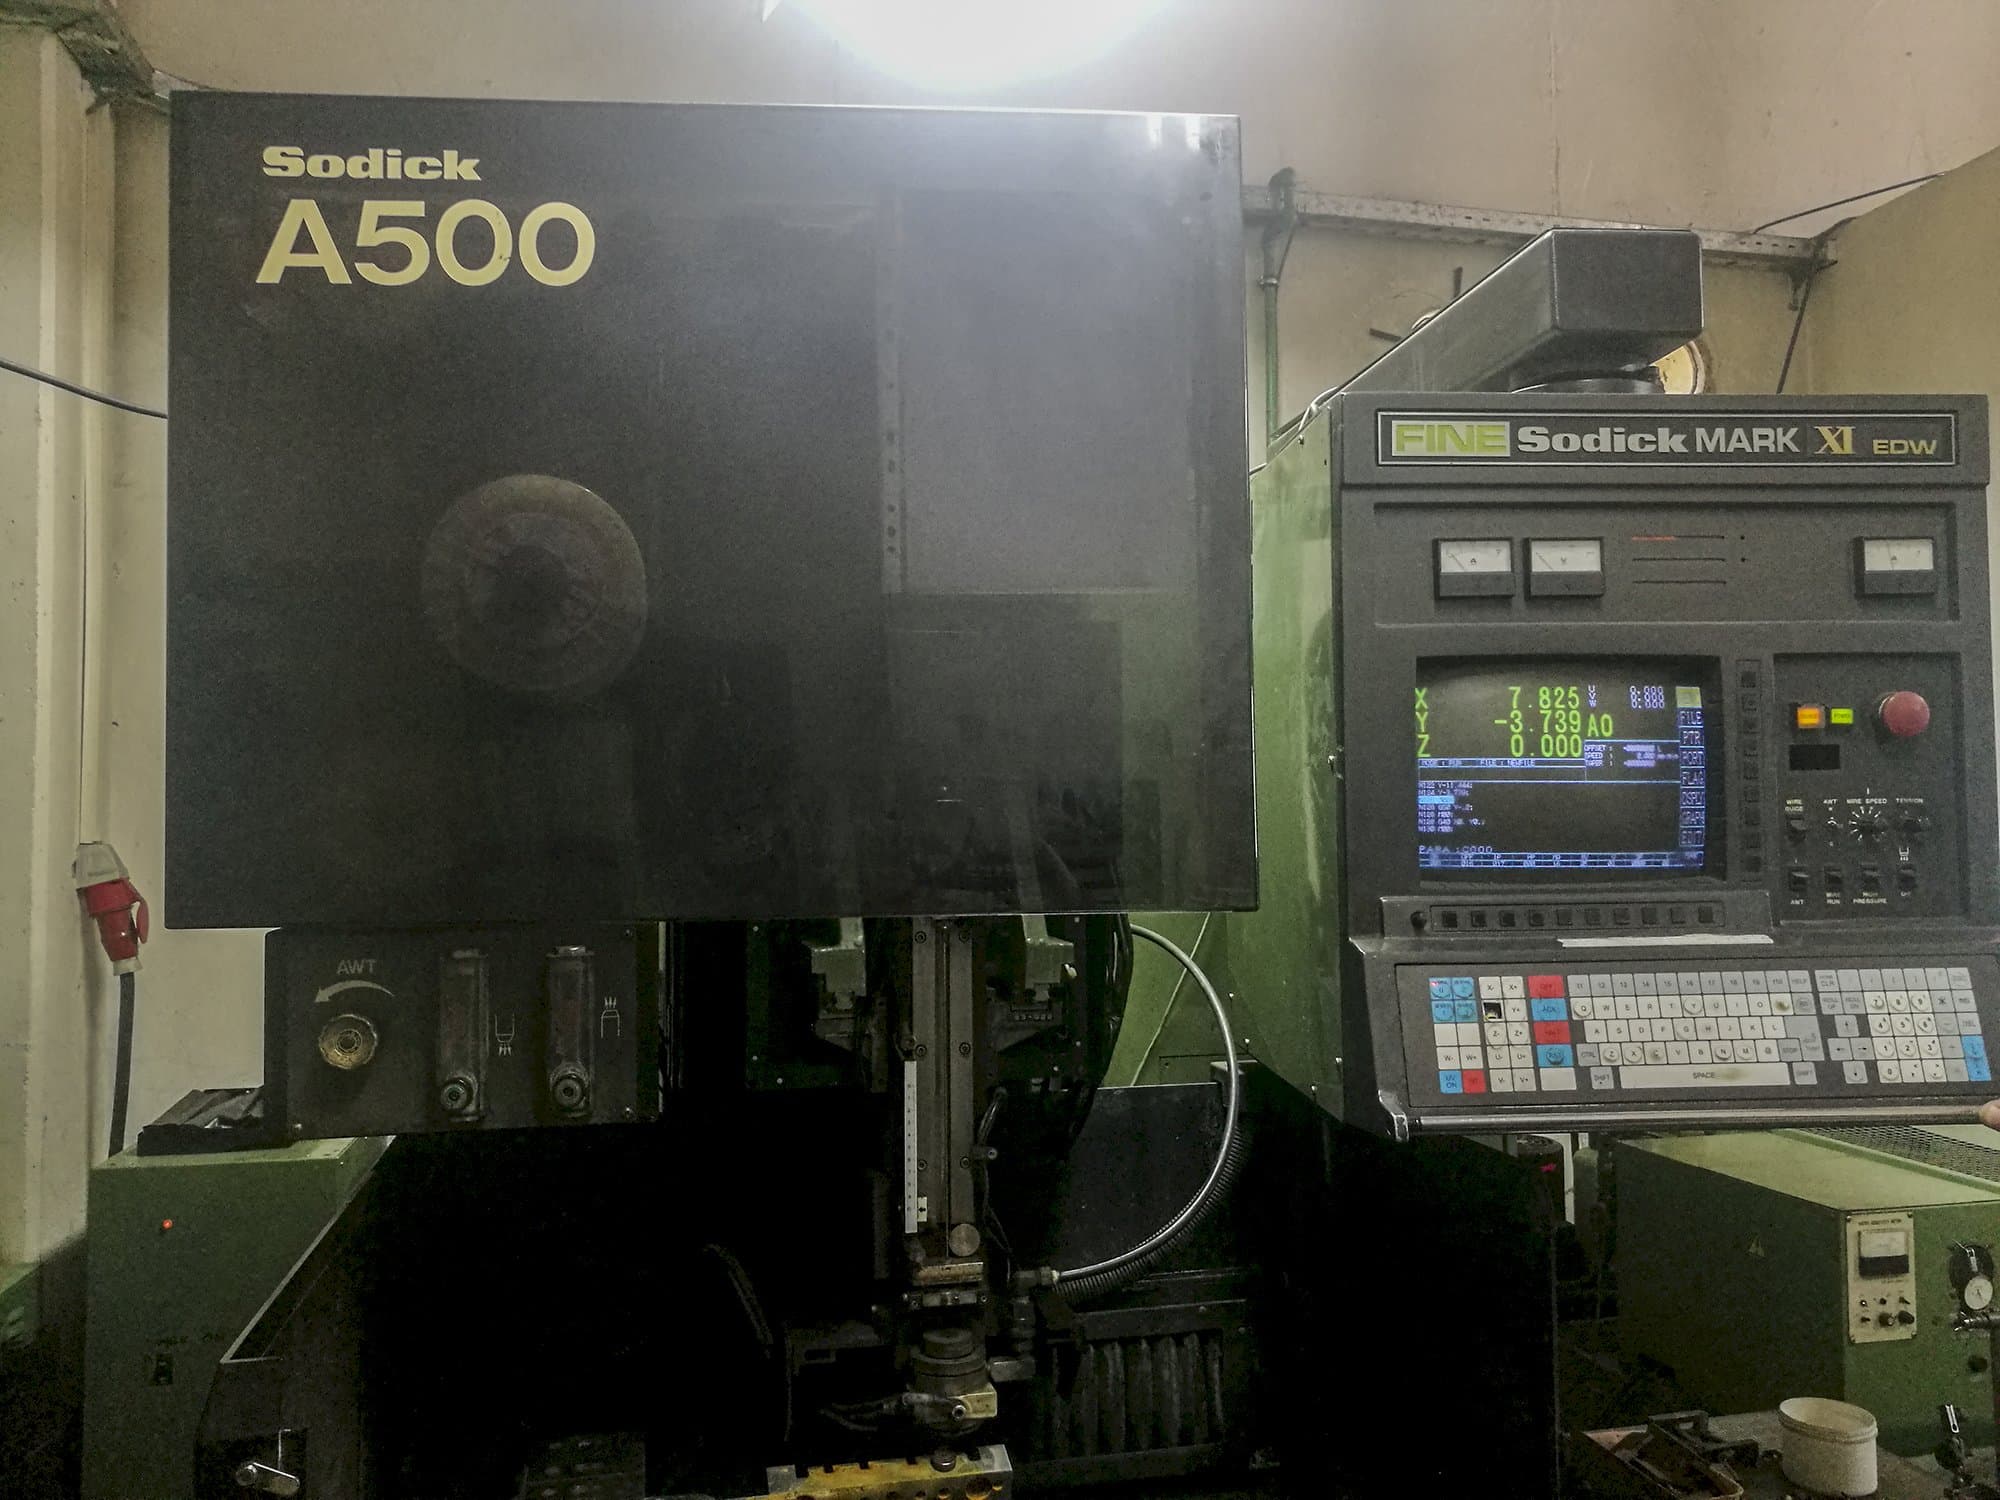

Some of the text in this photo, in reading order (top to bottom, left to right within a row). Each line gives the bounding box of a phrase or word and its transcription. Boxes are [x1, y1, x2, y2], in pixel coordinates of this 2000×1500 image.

[262, 146, 482, 181] Sodick
[255, 199, 596, 286] A500
[1395, 424, 1937, 455] FINE Sodick MARK XI EDW
[1415, 686, 1580, 709] X 7.825
[1415, 711, 1429, 733] Y
[1417, 733, 1582, 758] Z 0.000
[336, 959, 377, 975] AWT
